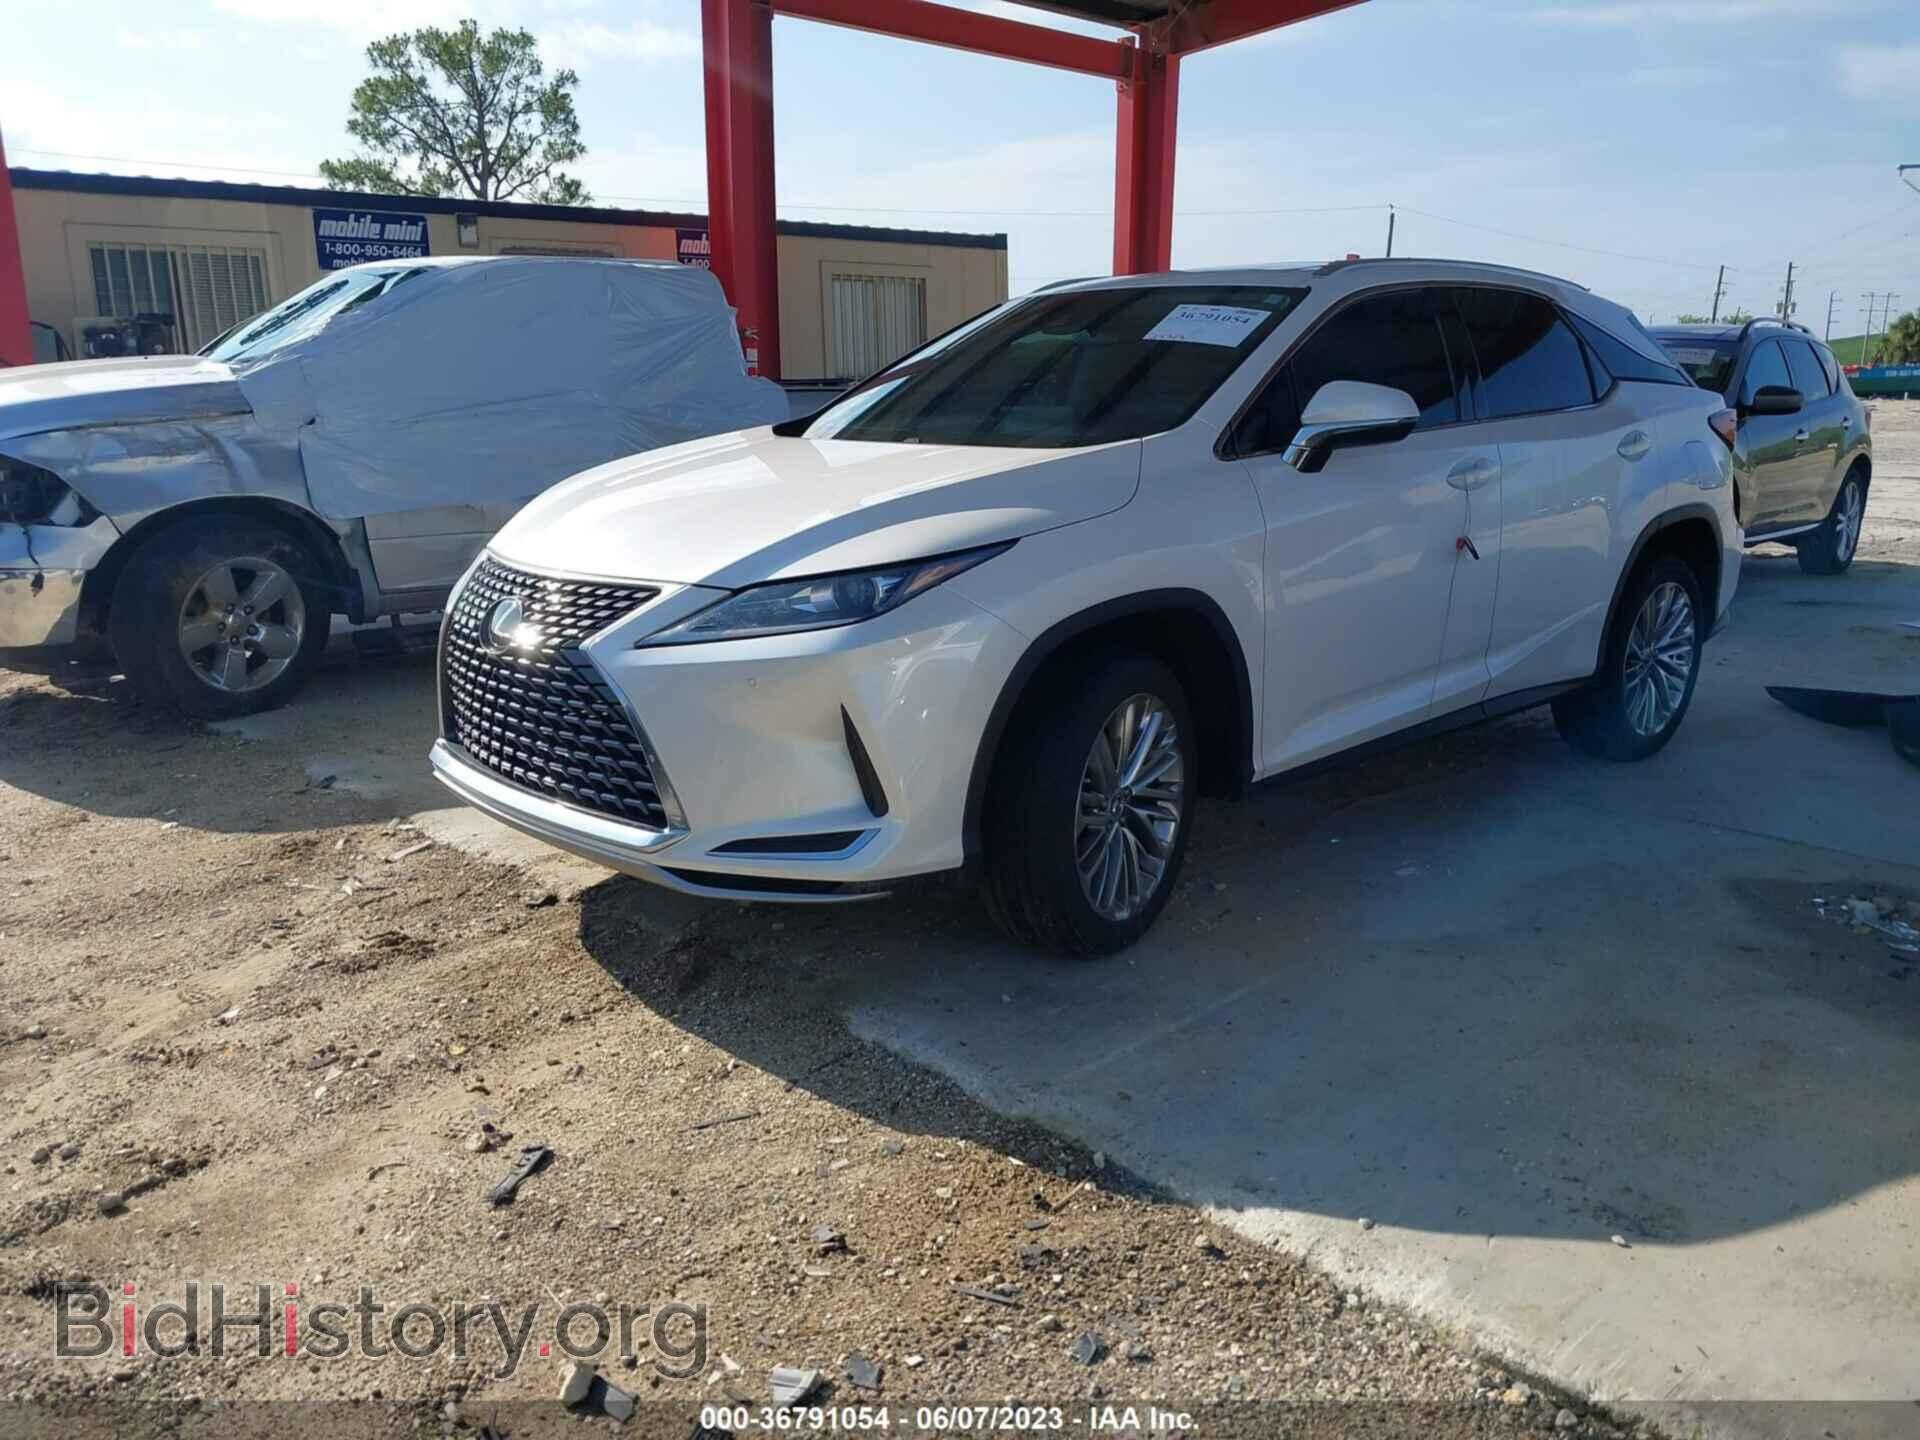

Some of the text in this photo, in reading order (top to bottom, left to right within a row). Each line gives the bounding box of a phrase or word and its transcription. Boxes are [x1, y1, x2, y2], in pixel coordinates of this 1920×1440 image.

[319, 213, 424, 241] mobile mini
[325, 242, 422, 259] 1-800-950-6464
